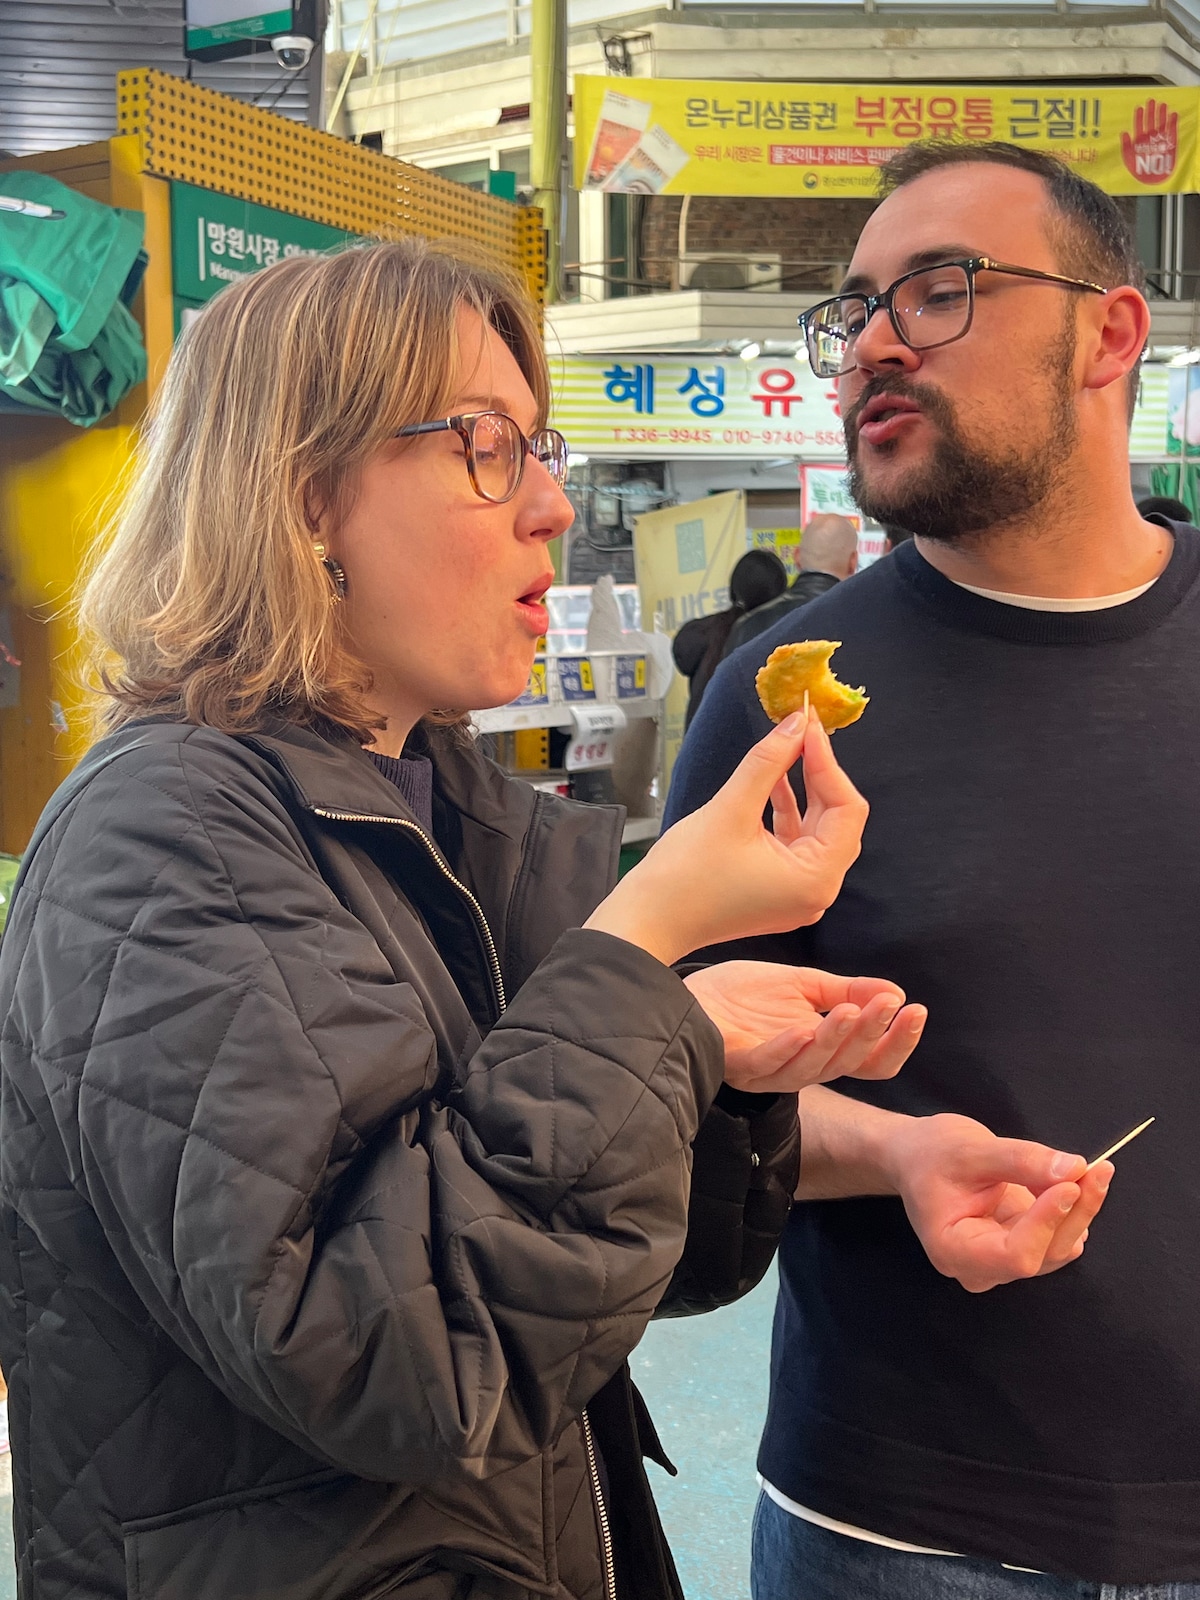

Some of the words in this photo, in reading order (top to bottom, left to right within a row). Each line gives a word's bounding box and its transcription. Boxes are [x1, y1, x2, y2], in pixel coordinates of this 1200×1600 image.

[684, 98, 838, 131] 온누리상품권
[854, 96, 994, 139] 부정유통
[1008, 98, 1102, 139] 근절!!
[1135, 153, 1172, 175] NO!
[207, 222, 280, 267] 망원시장
